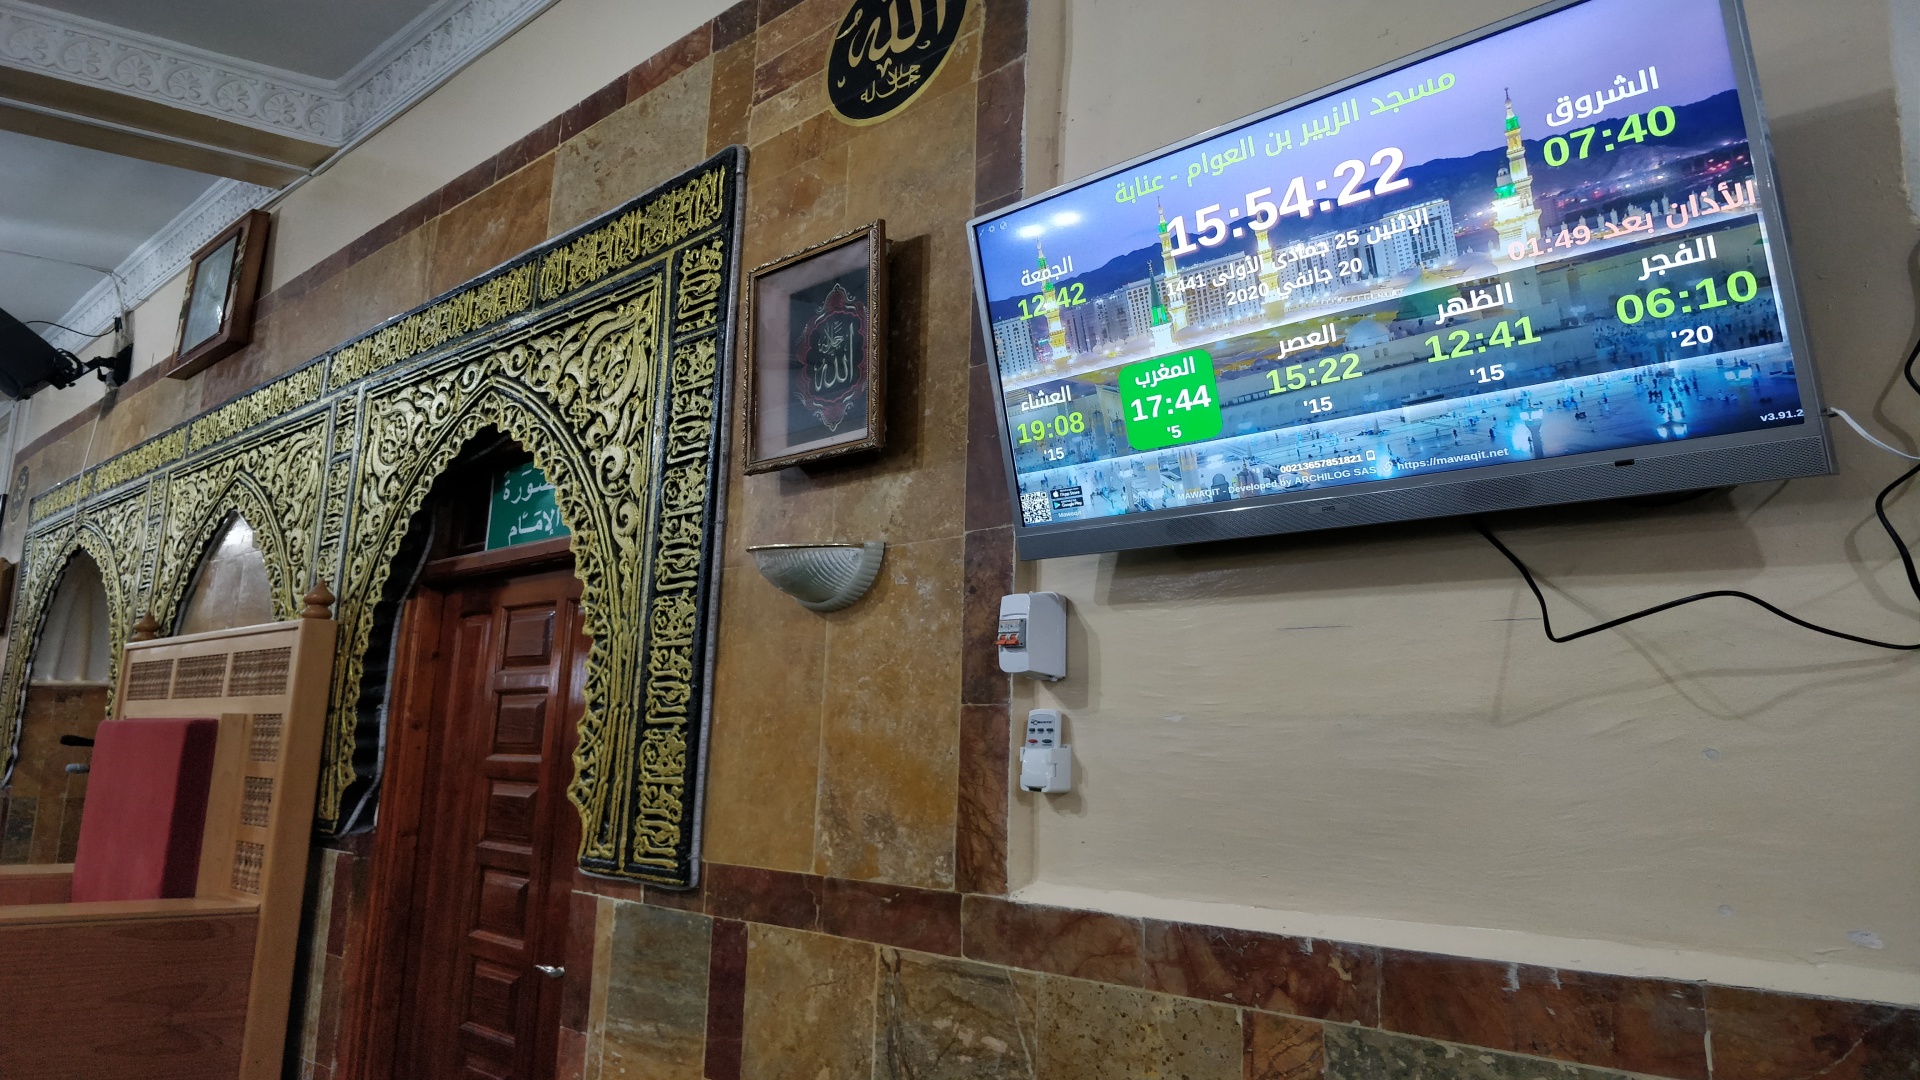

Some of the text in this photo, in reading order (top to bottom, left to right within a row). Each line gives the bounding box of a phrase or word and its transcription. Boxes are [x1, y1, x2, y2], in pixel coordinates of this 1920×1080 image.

[1369, 72, 1456, 117] مسجد
[1546, 66, 1660, 127] الشروق
[1264, 128, 1292, 157] بن
[1299, 98, 1360, 146] الزبير
[1543, 105, 1676, 167] 07:40
[1187, 135, 1255, 186] العوام
[1115, 171, 1164, 204] عنابة
[1167, 146, 1409, 257] 15:54:22
[1507, 180, 1757, 261] الأذان بعد 01:49
[1020, 255, 1074, 287] الجمعة
[1165, 207, 1429, 296] الإثنين 25 جمادى الأولى 1441
[1638, 234, 1717, 282] الفجر
[1017, 282, 1087, 321] 12:42
[1226, 257, 1362, 306] 20 جانفي 2020
[1616, 270, 1758, 325] 06:10
[1435, 282, 1514, 325] الظهر
[1278, 323, 1337, 360] العصر
[1424, 315, 1542, 364] 12:41
[1135, 355, 1196, 387] المغرب
[1265, 353, 1363, 395] 15:22
[1021, 384, 1072, 412] العشاء
[1130, 384, 1212, 422] 17:44
[1760, 408, 1804, 422] v3.91.2
[1016, 411, 1085, 444] 19:08
[1280, 454, 1363, 473] 00213657851821
[1397, 448, 1509, 471] https://mawaqit.net
[1176, 488, 1220, 501] MAWAQIT
[1229, 480, 1277, 494] Developed
[1279, 478, 1292, 488] by
[1294, 470, 1350, 485] ARCHILOG
[1354, 466, 1377, 476] SAS
